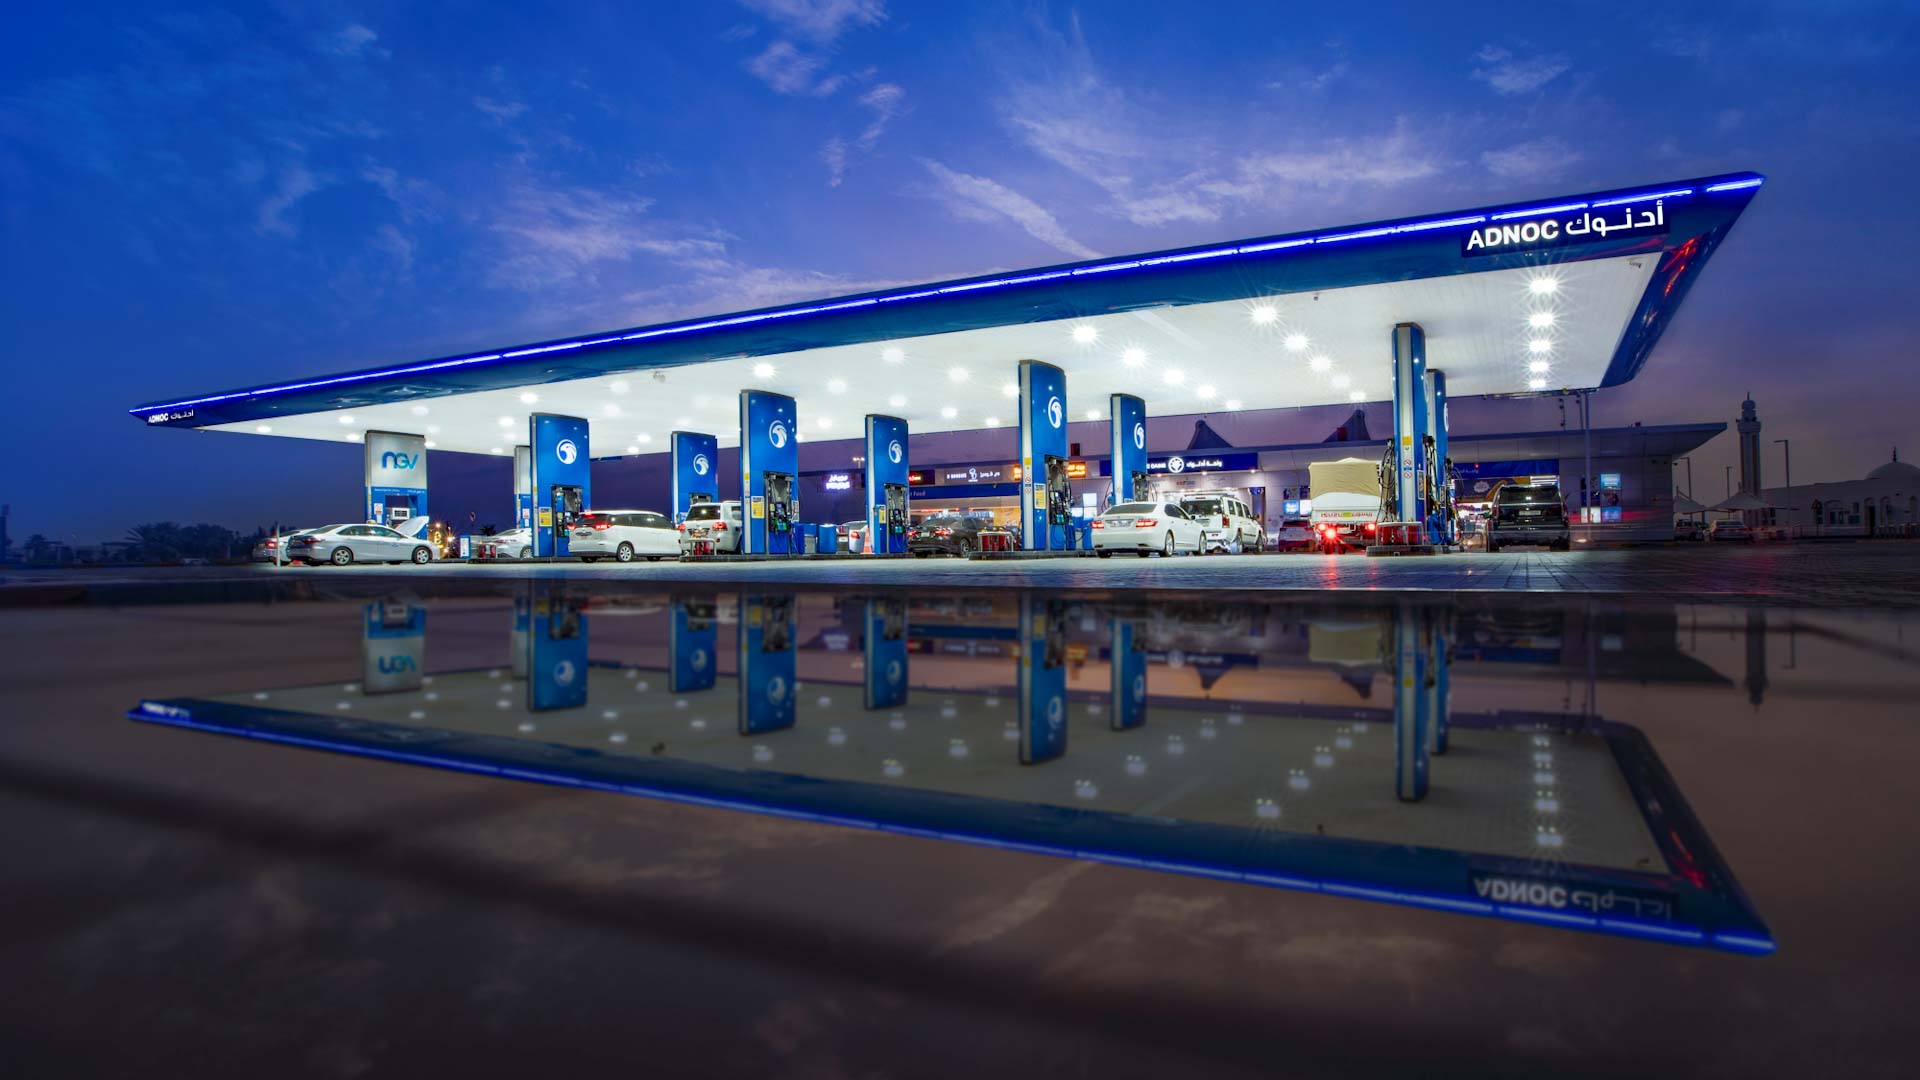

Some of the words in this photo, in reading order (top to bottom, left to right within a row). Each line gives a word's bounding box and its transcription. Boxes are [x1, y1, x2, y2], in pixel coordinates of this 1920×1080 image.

[1565, 200, 1664, 238] أدنوك
[1466, 220, 1559, 250] ADNOC
[148, 413, 169, 424] ADNOC
